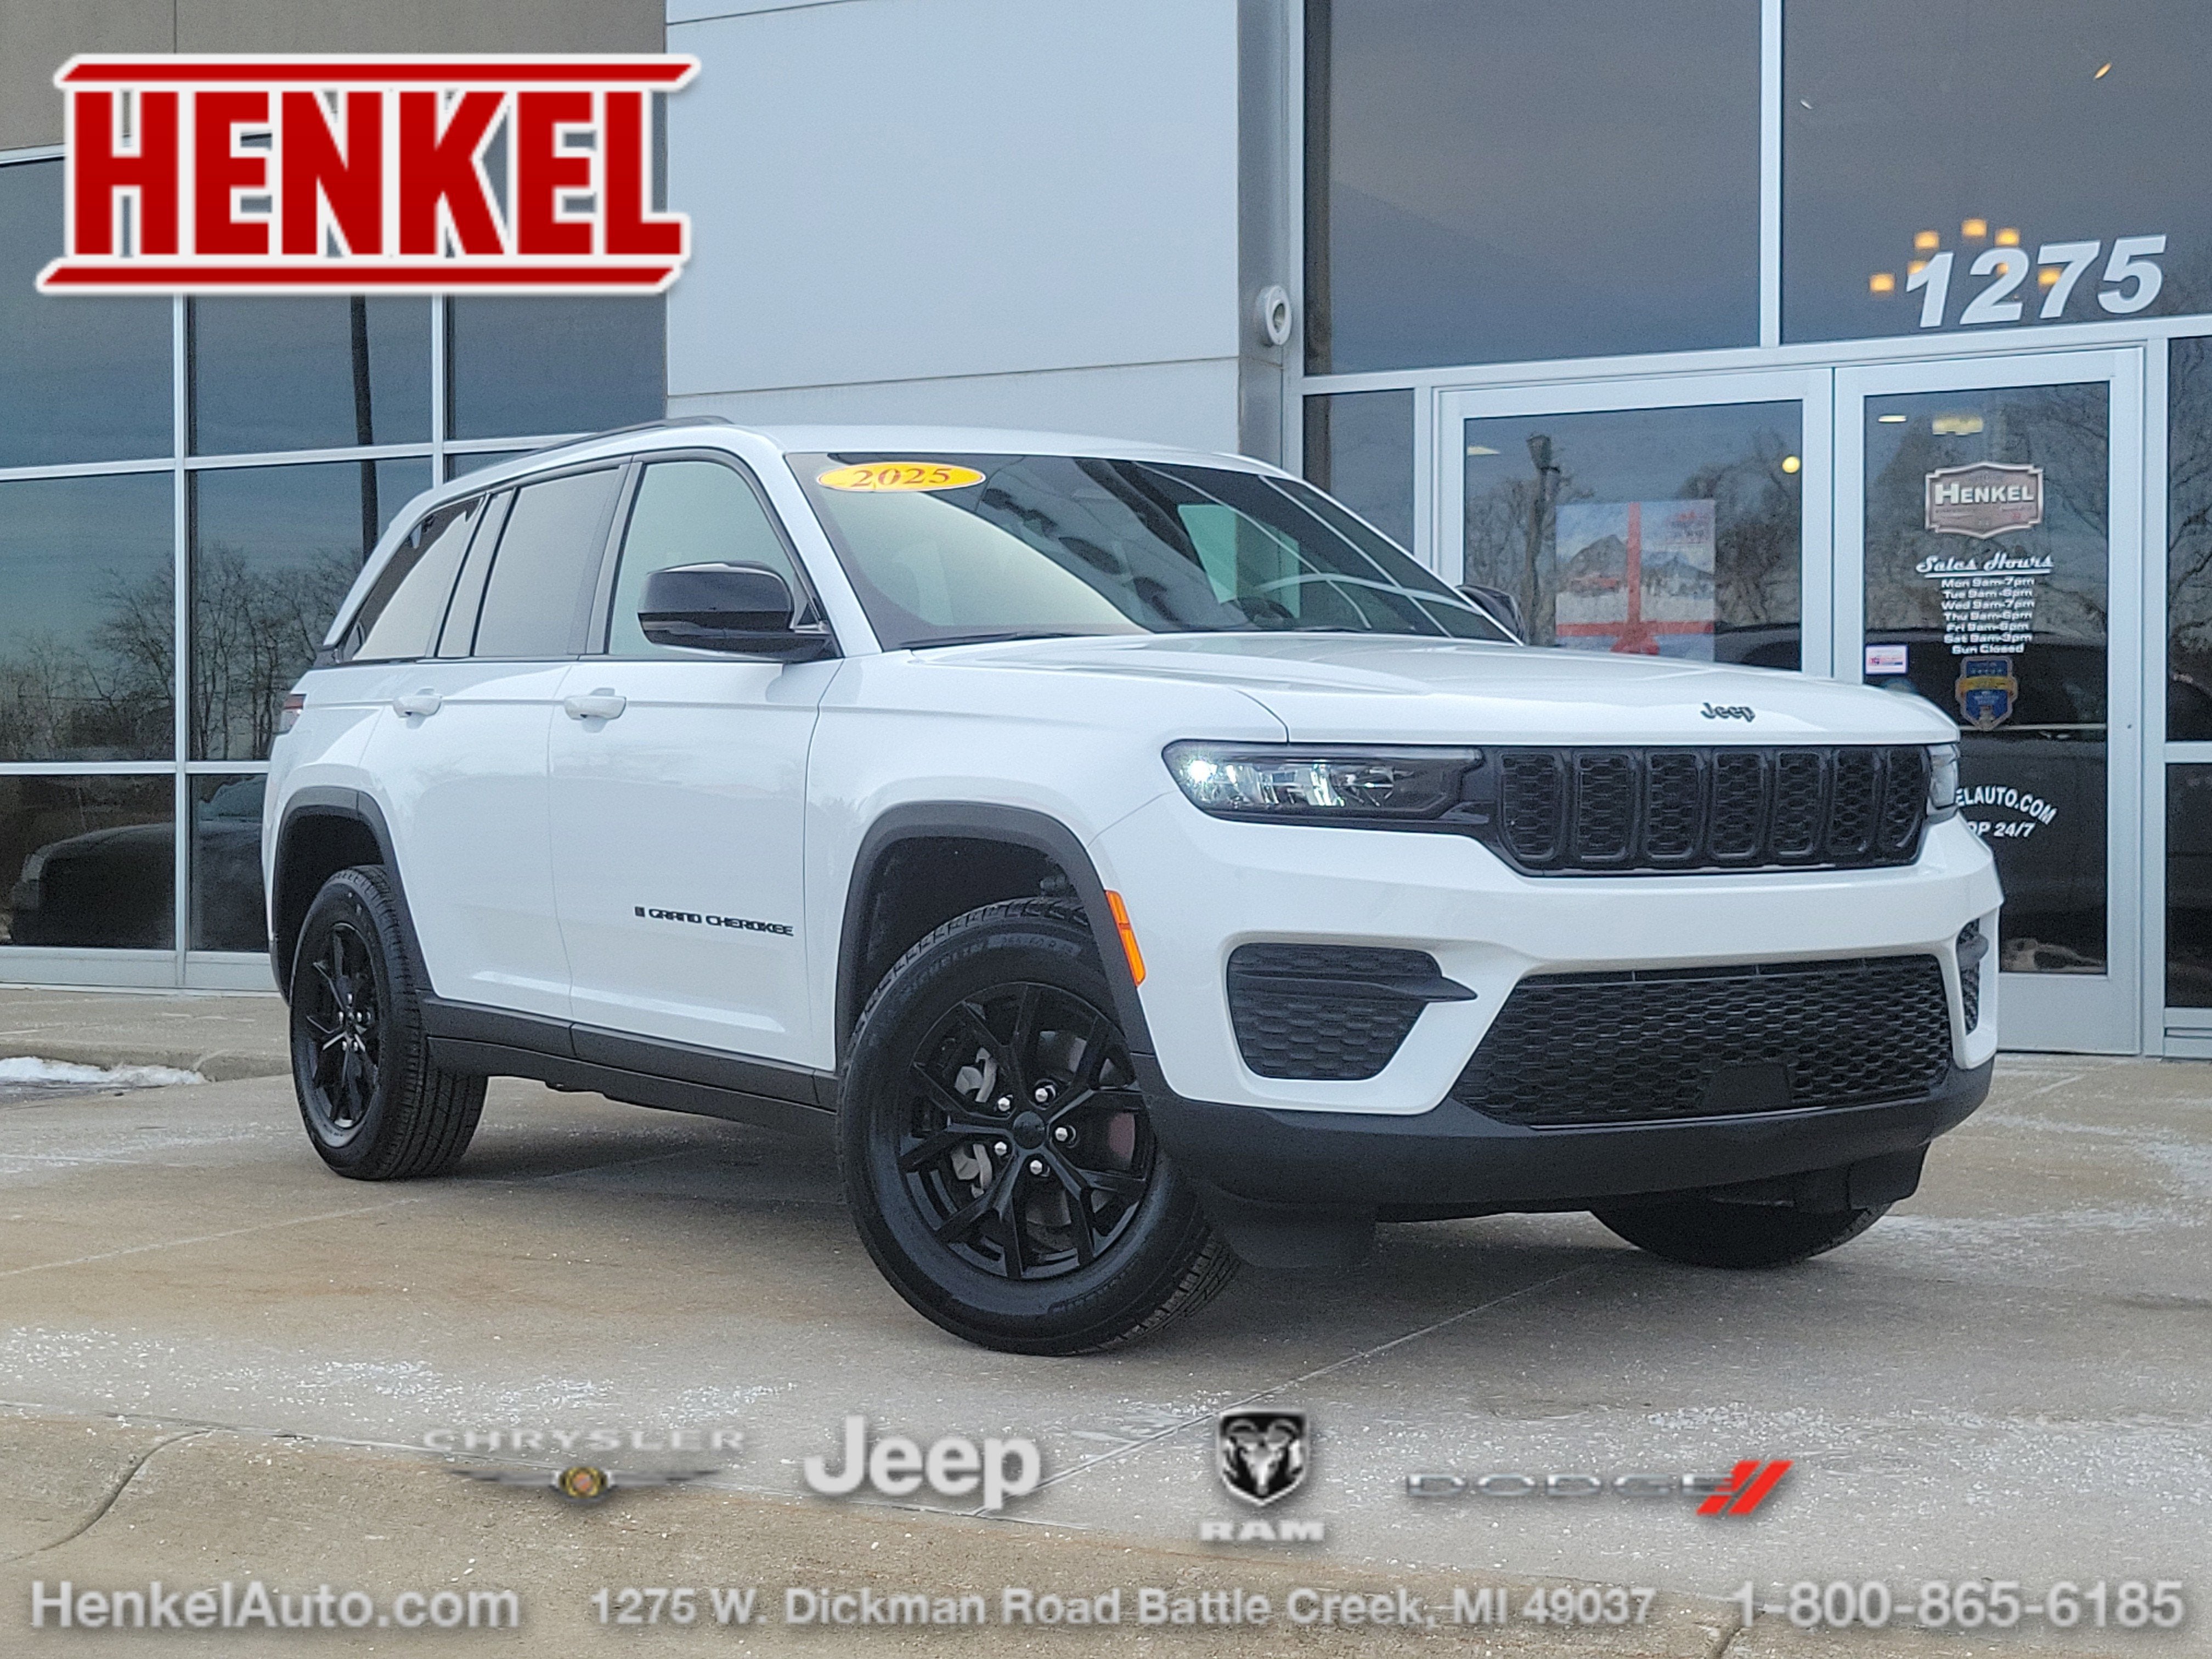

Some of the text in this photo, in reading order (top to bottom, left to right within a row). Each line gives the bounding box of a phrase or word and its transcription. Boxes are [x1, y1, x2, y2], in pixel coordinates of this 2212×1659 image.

[1905, 234, 2166, 328] 1275
[851, 468, 952, 487] 2025
[1934, 482, 2035, 505] HENKEL
[1915, 551, 2055, 573] Sales Hours
[1941, 578, 1970, 588] Mon
[1942, 590, 1966, 599] Tue
[1941, 601, 1971, 610] Wed
[1943, 611, 1968, 620] Thu
[1946, 623, 1966, 632] Fri
[1944, 634, 1968, 643] Sat
[1952, 644, 2024, 654] Sun Closed
[1701, 702, 1756, 723] Jeep
[1994, 822, 2035, 837] 24/7
[648, 909, 794, 936] GRAND CHEROKEE
